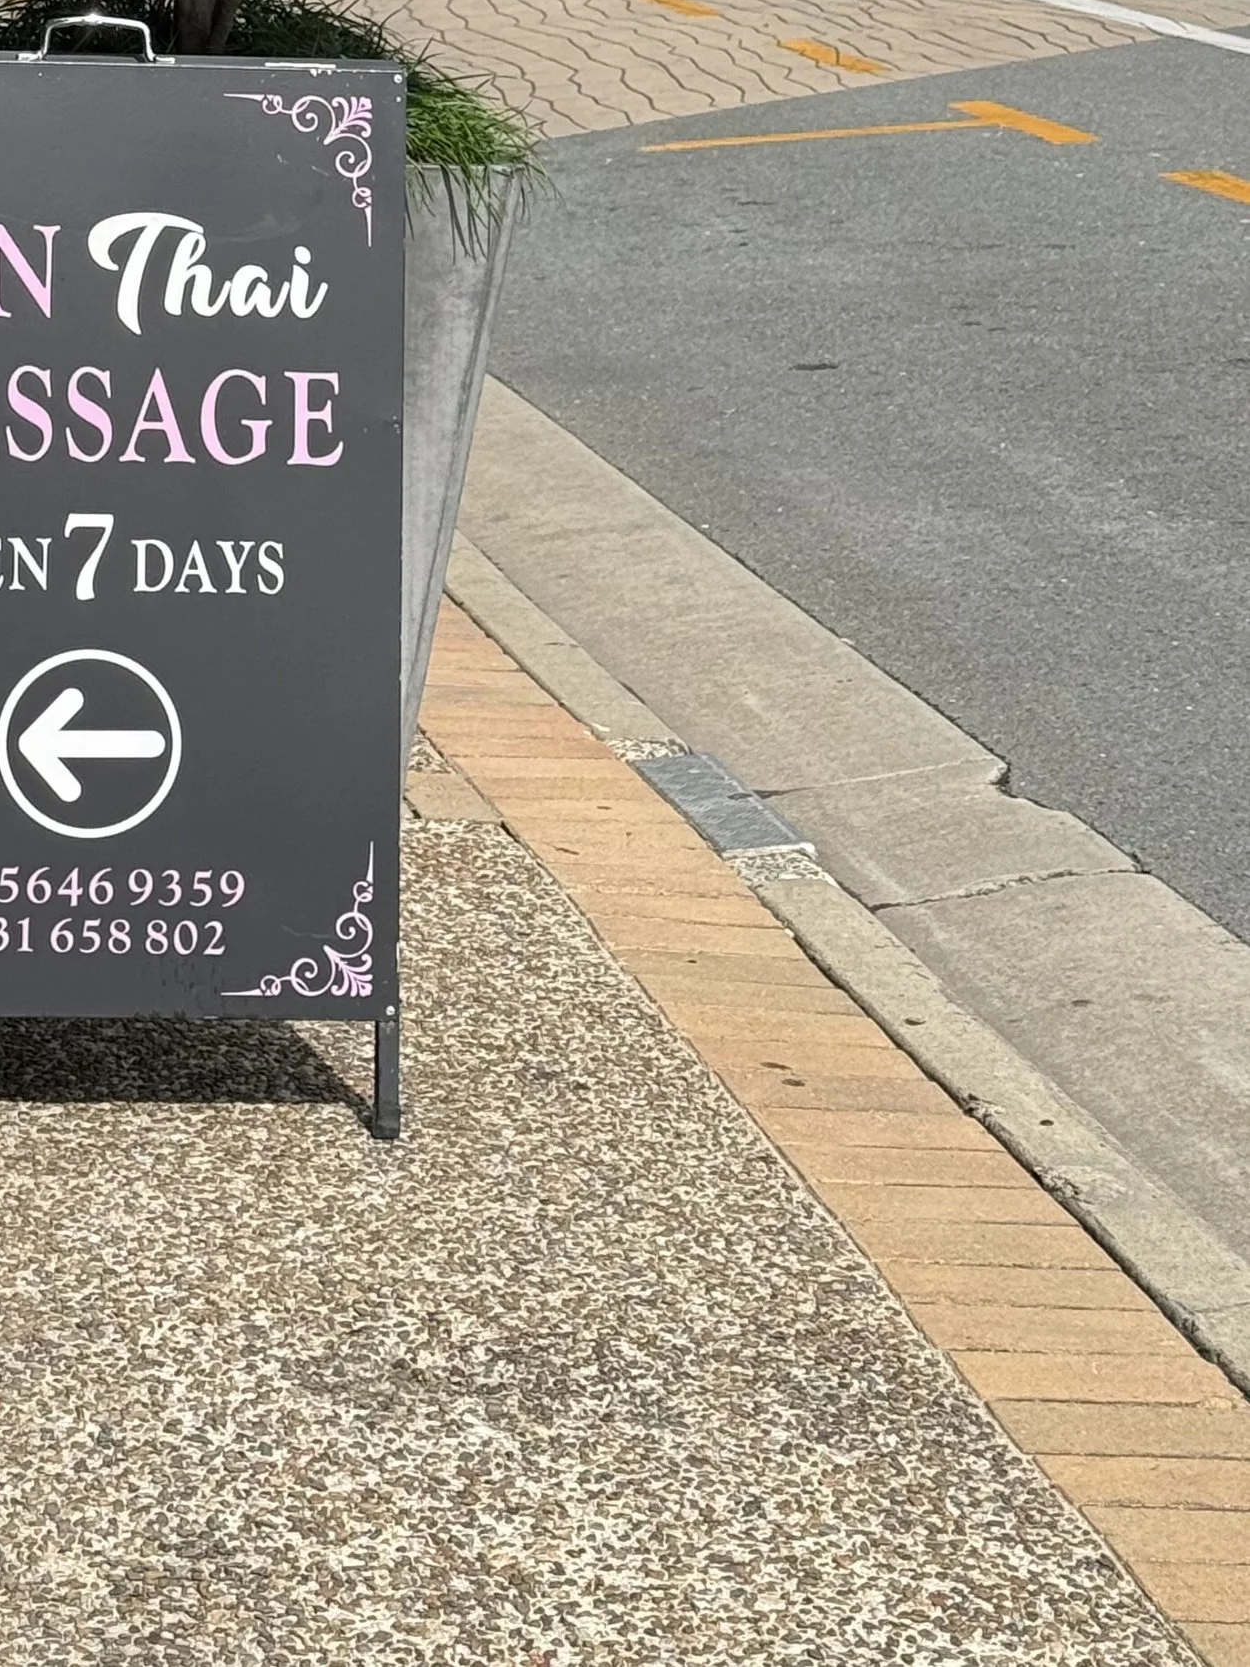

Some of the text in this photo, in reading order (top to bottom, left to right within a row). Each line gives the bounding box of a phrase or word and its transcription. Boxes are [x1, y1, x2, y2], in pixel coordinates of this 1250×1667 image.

[86, 211, 328, 335] Thai
[64, 513, 114, 601] 7
[131, 539, 285, 595] DAYS
[128, 867, 246, 909] 9359
[50, 917, 132, 955] 658
[144, 919, 226, 957] 802
